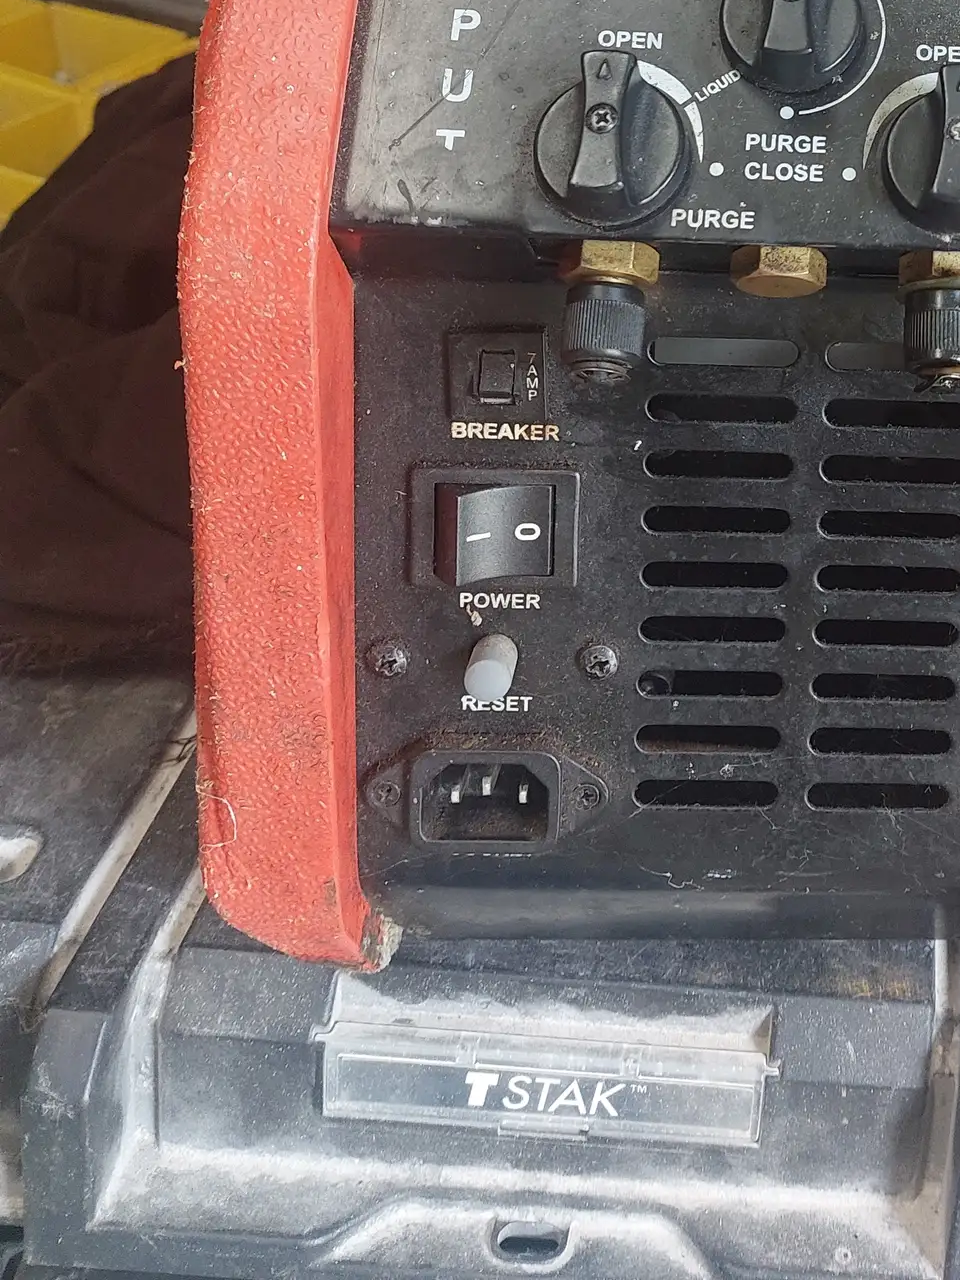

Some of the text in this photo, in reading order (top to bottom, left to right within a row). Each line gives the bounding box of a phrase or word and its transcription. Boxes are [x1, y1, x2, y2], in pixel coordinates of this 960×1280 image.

[597, 29, 664, 50] OPEN
[694, 68, 742, 103] LIQUID
[744, 133, 827, 155] PURGE
[744, 161, 824, 183] CLOSE
[670, 208, 756, 230] PURGE
[526, 365, 539, 402] AMP
[451, 421, 560, 441] BREAKER
[459, 591, 541, 610] POWER
[461, 694, 533, 713] RESET
